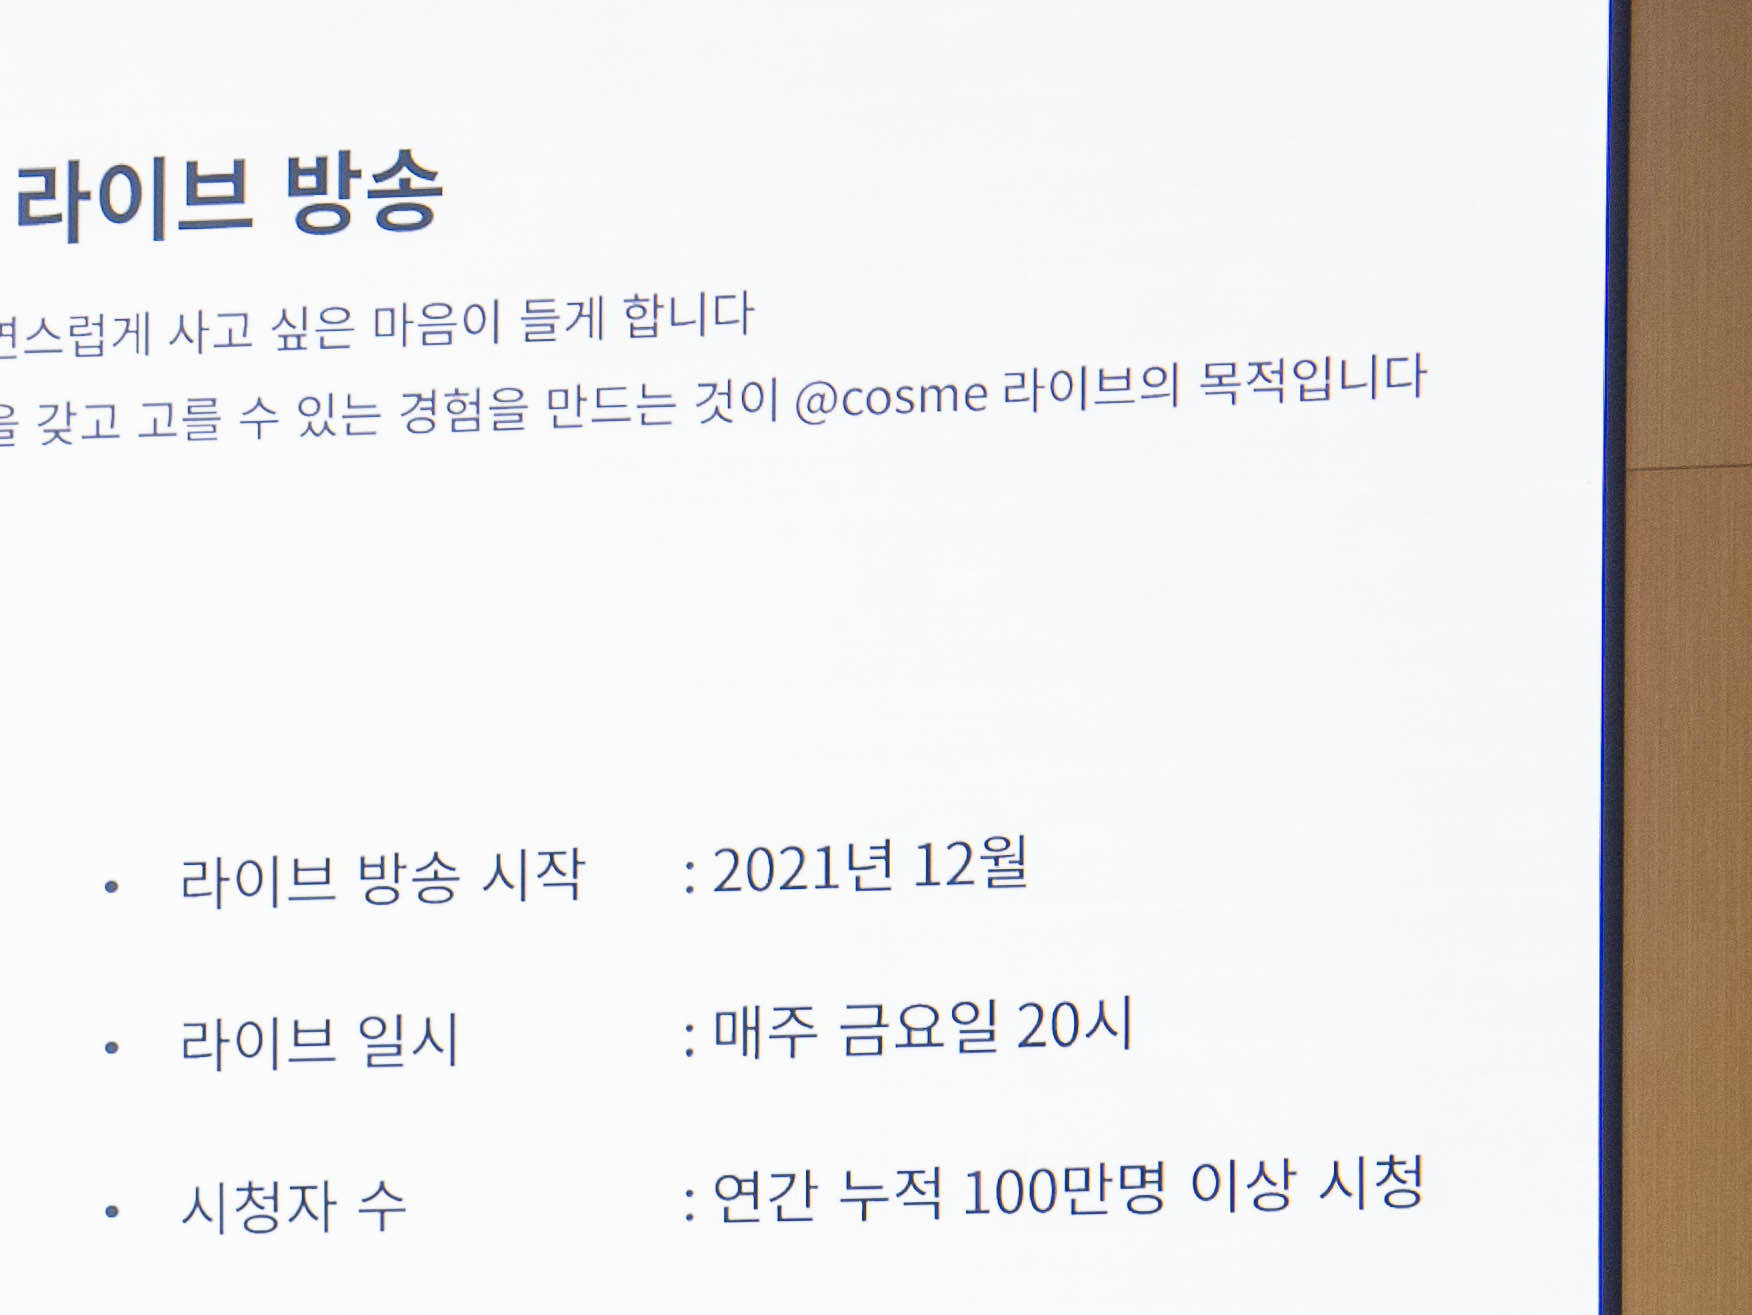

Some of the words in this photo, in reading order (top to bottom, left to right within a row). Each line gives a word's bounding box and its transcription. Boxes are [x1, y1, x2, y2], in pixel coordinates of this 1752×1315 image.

[18, 156, 253, 244] 라이브
[288, 149, 443, 235] 방송
[169, 310, 252, 354] 사고
[272, 306, 354, 351] 싶은
[375, 299, 498, 347] 마음이
[521, 295, 603, 342] 들게
[624, 290, 755, 338] 합니다
[38, 401, 120, 445] 갖고
[138, 398, 221, 441] 고를
[240, 397, 279, 439] 수
[298, 393, 381, 437] 있는
[400, 388, 528, 434] 경험을
[548, 384, 676, 429] 만드는
[696, 377, 776, 424] 것이
[796, 374, 988, 423] @cosme
[1004, 362, 1178, 413] 라이브의
[1200, 352, 1428, 405] 목적입니다
[183, 856, 336, 910] 라이브
[360, 851, 460, 905] 방송
[483, 847, 586, 902] 시작
[714, 838, 891, 892] 2021년
[915, 835, 1026, 888] 12월
[184, 1017, 336, 1072] 라이브
[360, 1013, 456, 1068] 일시
[716, 1005, 818, 1060] 매주
[840, 999, 997, 1056] 금요일
[1018, 995, 1130, 1050] 20시
[182, 1180, 337, 1235] 시청자
[358, 1181, 406, 1232] 수
[715, 1169, 818, 1223] 연간
[840, 1167, 940, 1222] 누적
[966, 1161, 1164, 1215] 100만명
[1192, 1158, 1298, 1213] 이상
[1320, 1154, 1422, 1210] 시청
